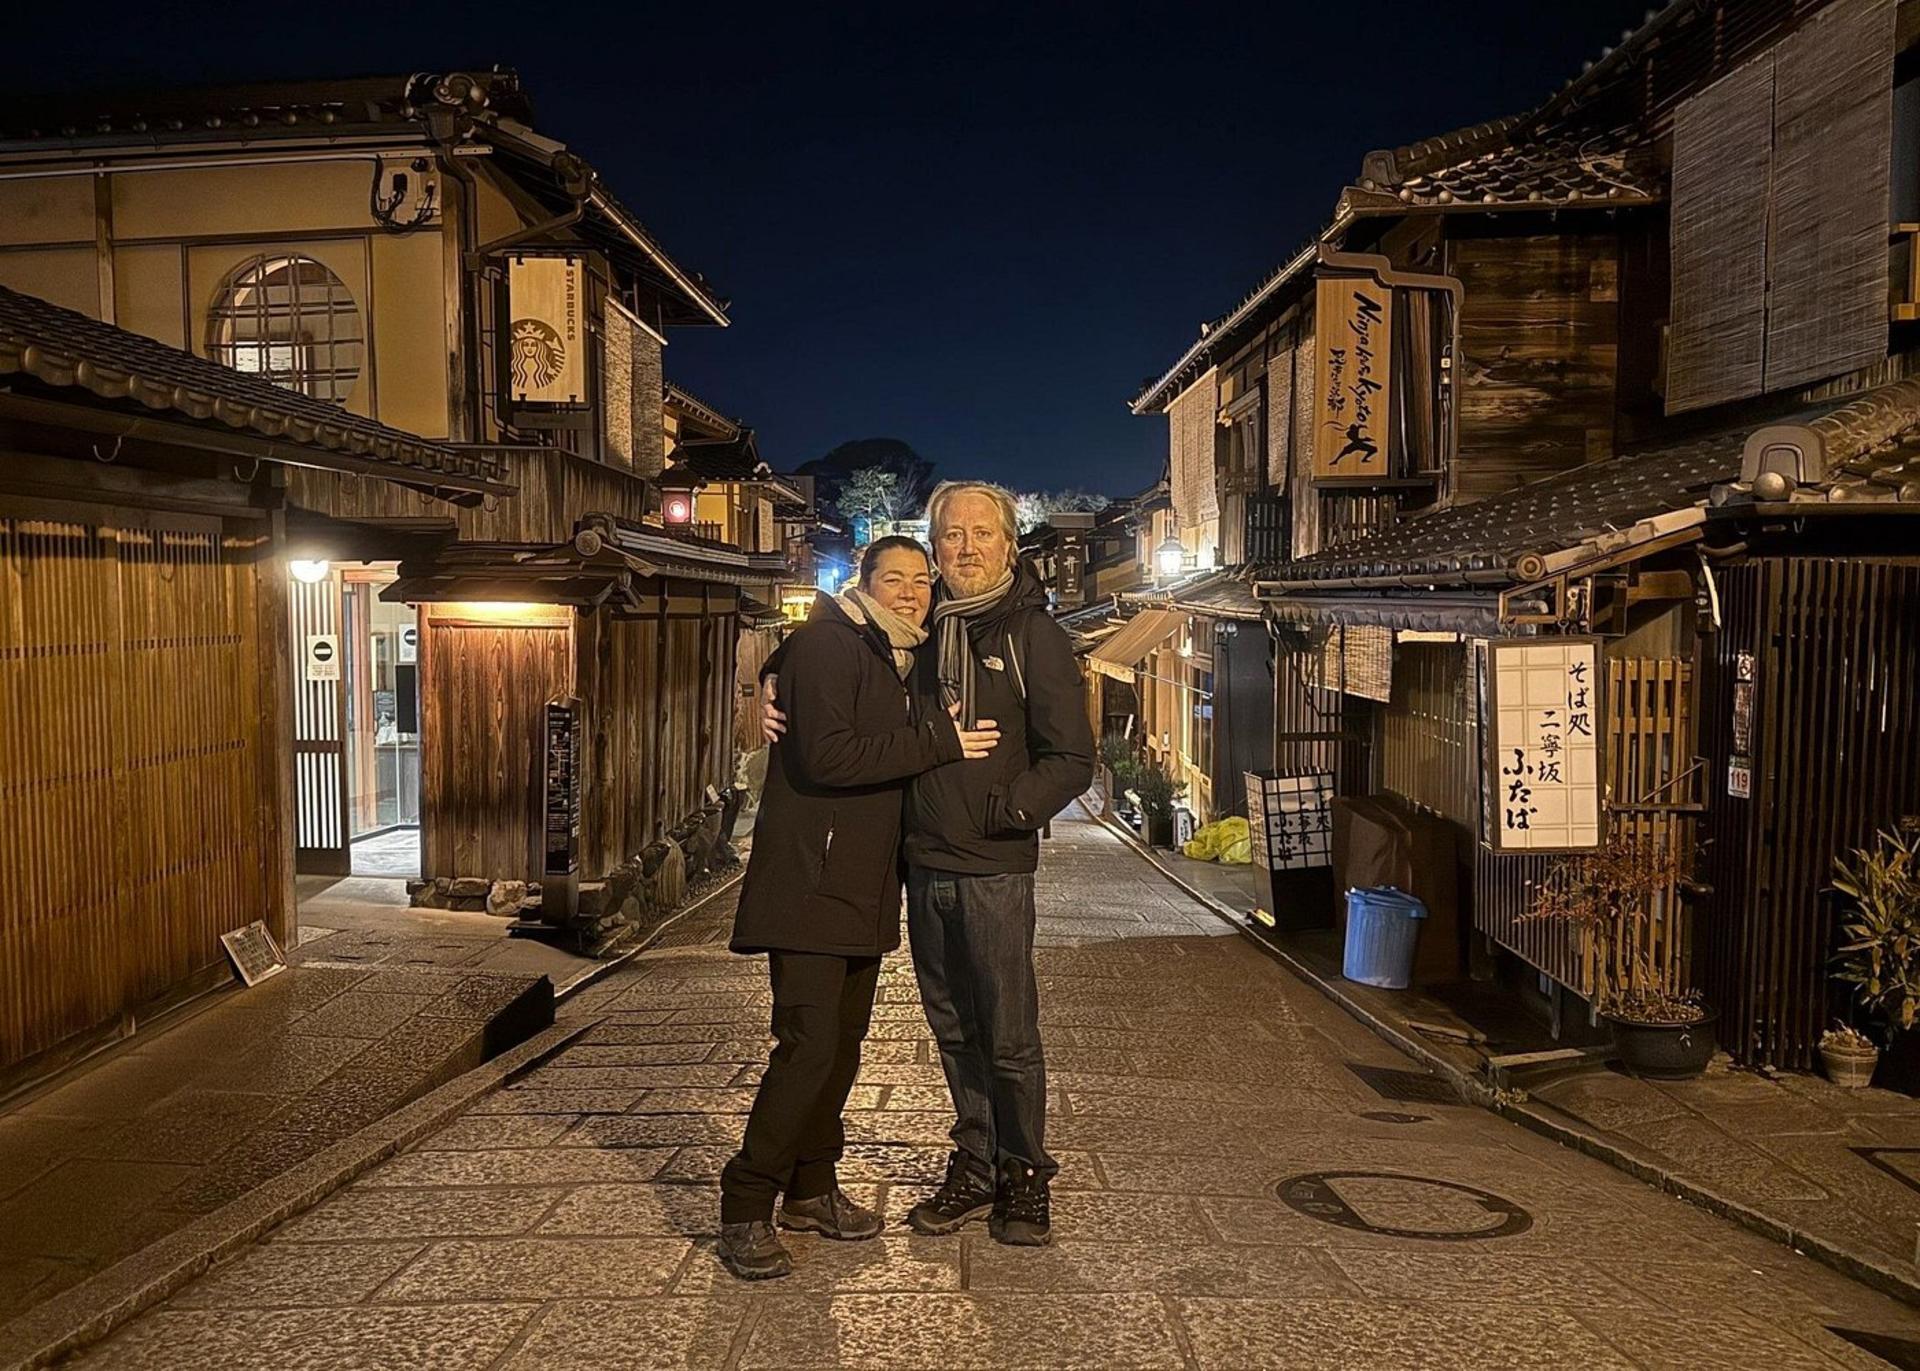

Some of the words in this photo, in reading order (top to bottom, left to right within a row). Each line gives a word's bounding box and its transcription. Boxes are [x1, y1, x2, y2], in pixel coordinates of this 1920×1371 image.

[566, 269, 576, 341] STARBUCKS
[1348, 290, 1382, 346] Ninja
[1348, 375, 1382, 423] Kyoto
[1567, 661, 1592, 736] そば処
[1538, 710, 1563, 784] 二寧坂
[1731, 770, 1748, 788] 119
[1503, 748, 1538, 830] ふたば
